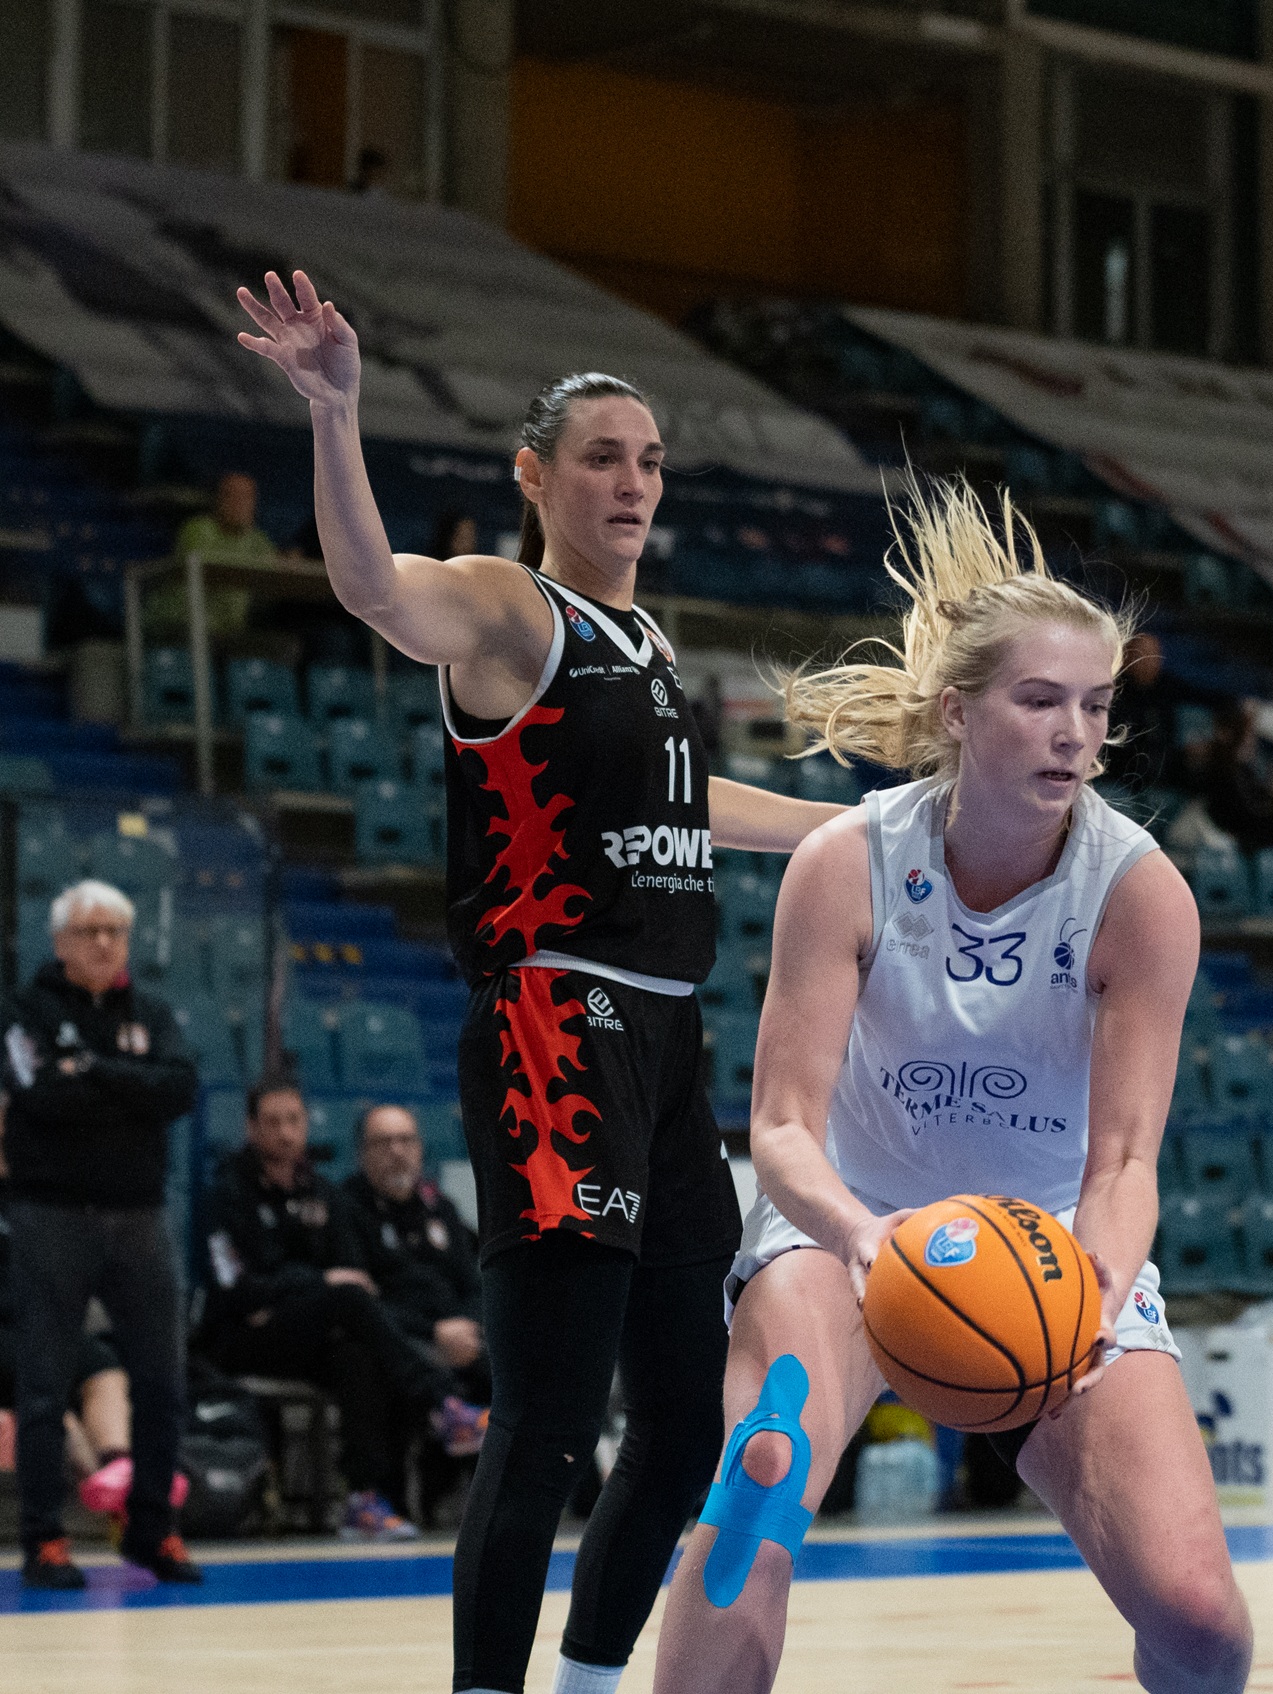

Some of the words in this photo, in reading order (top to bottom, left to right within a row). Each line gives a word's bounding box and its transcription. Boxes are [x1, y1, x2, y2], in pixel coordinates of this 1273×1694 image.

[654, 706, 679, 719] BITRE
[665, 736, 692, 804] 11
[601, 825, 714, 869] REPOWE
[684, 874, 704, 892] che
[946, 922, 1027, 987] 33
[880, 1066, 962, 1121] TERME
[971, 1101, 1067, 1133] SALUS
[577, 1183, 641, 1224] EA7
